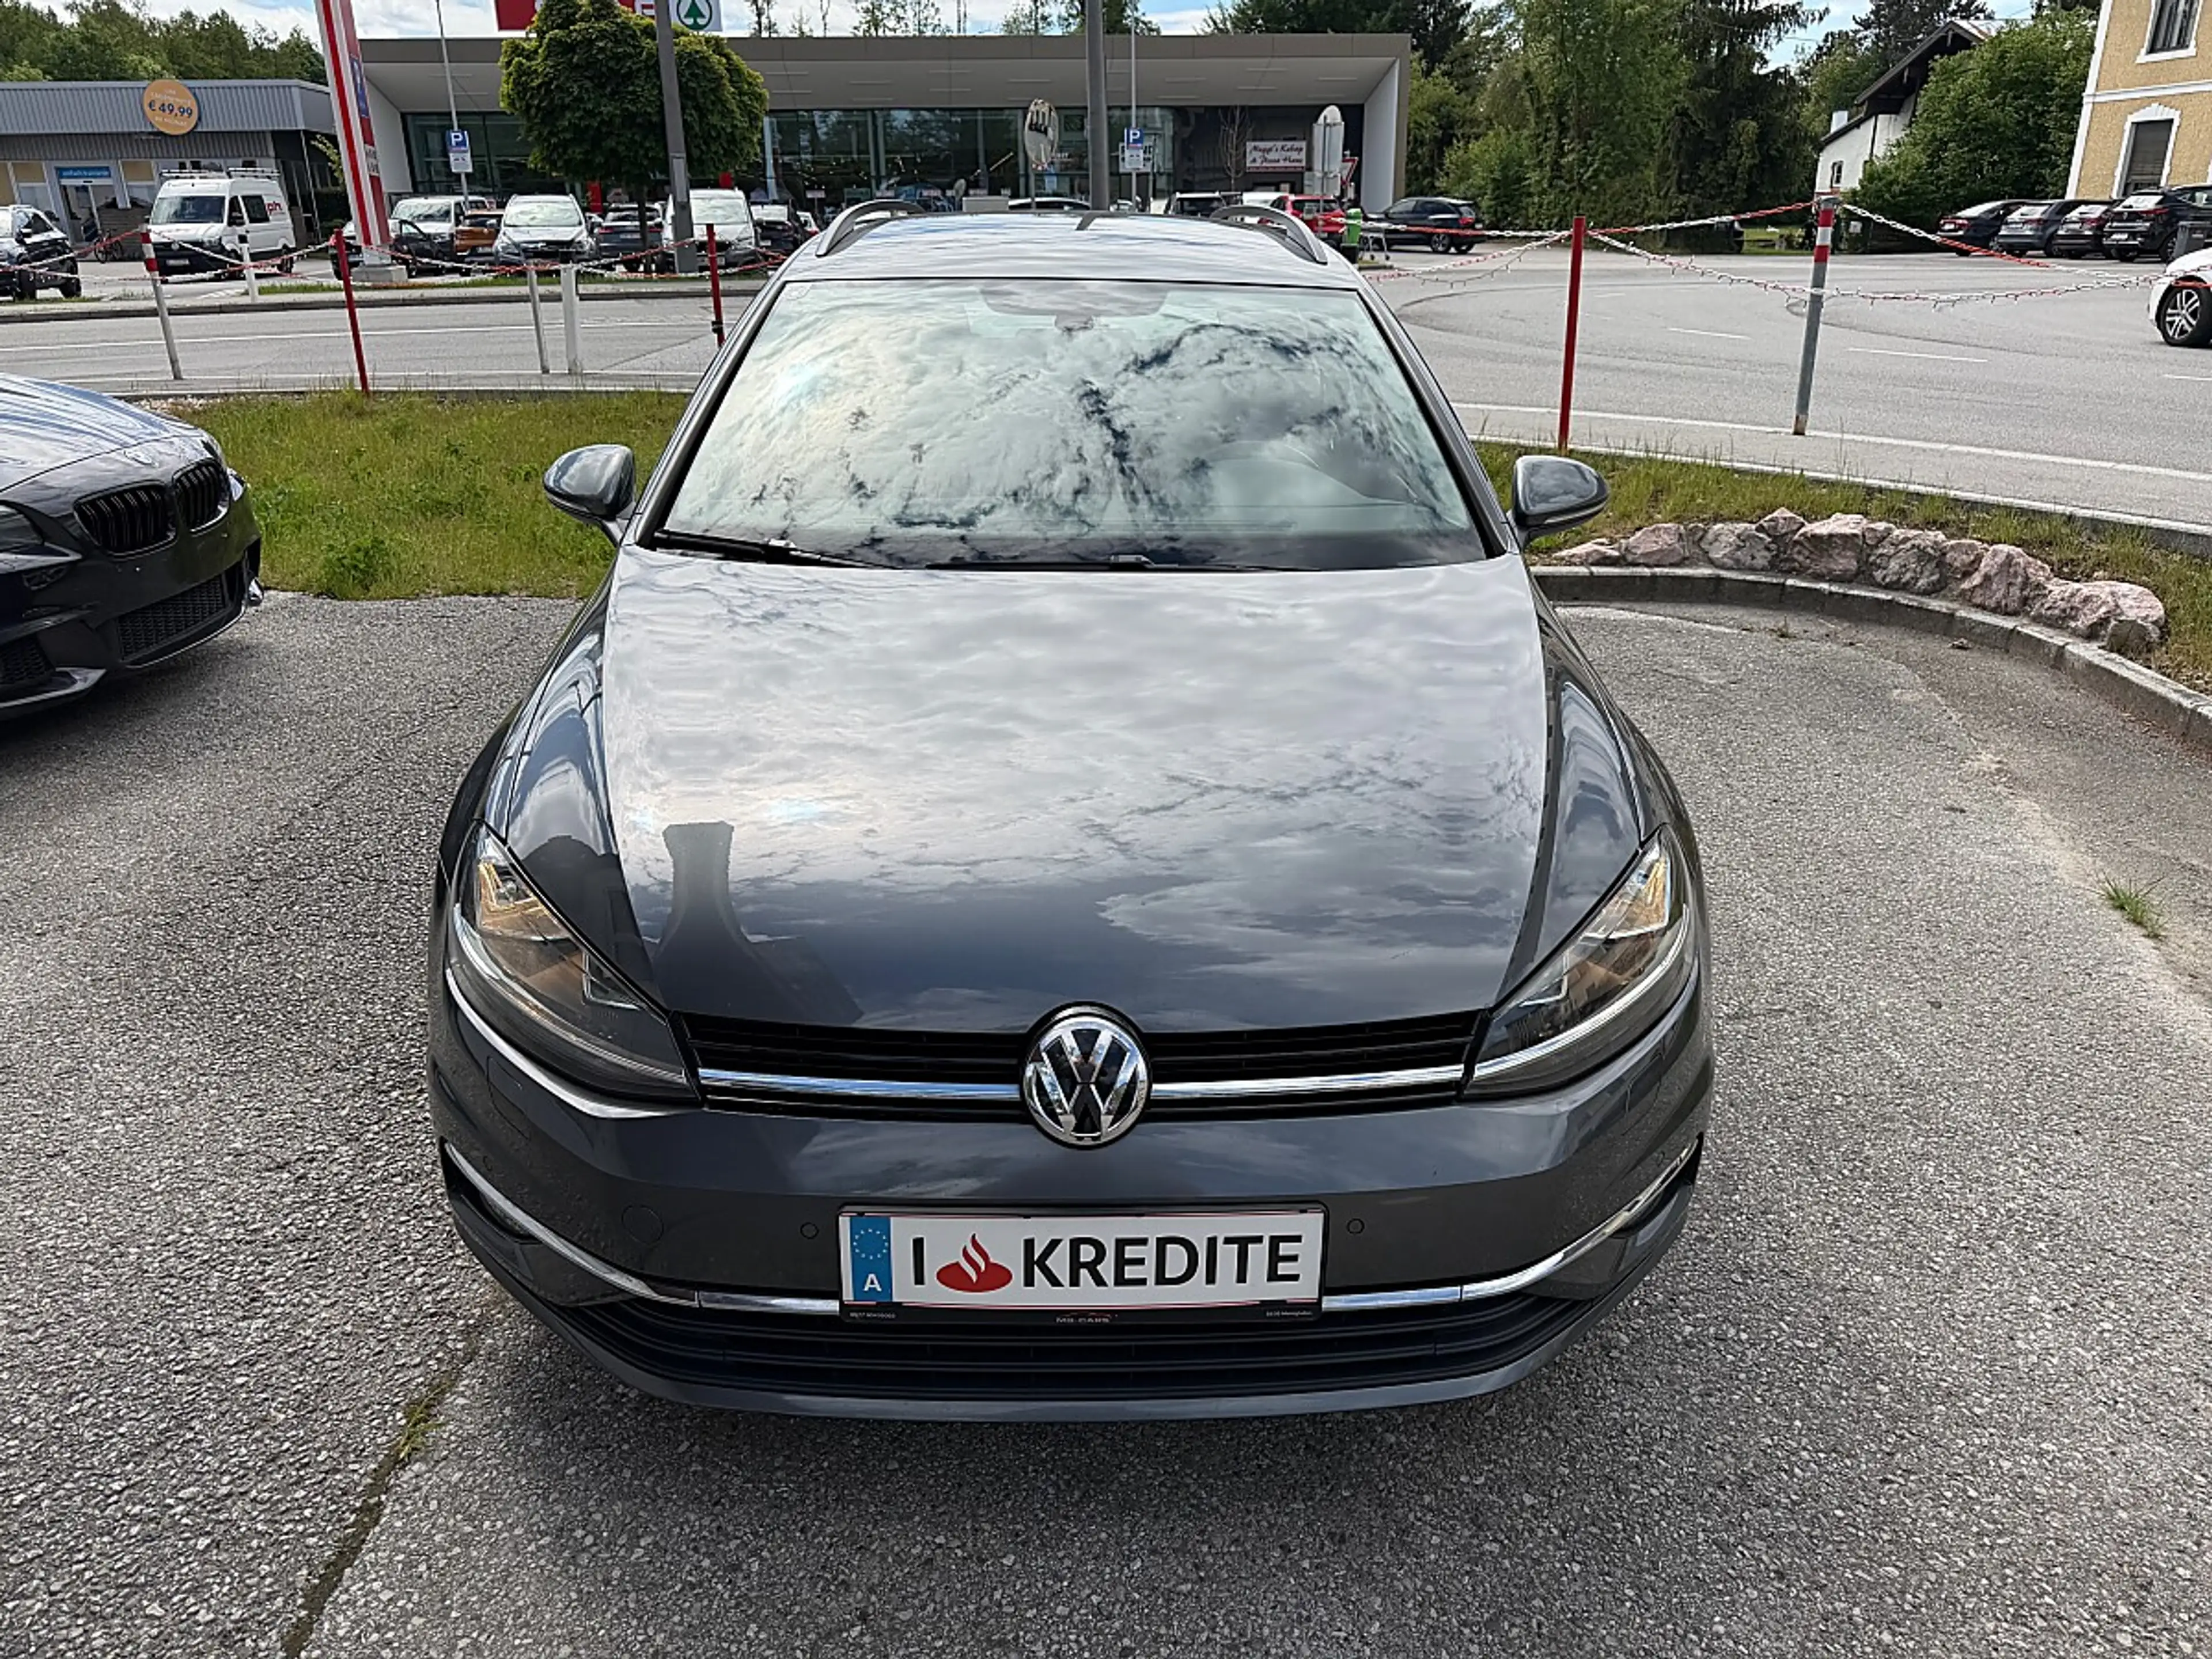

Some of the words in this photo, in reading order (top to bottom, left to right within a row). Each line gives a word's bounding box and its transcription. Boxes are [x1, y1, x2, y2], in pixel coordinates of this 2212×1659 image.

[452, 132, 463, 146] P
[1130, 130, 1141, 143] P
[912, 1237, 925, 1285] I
[1022, 1234, 1303, 1288] KREDITE
[863, 1273, 882, 1291] A
